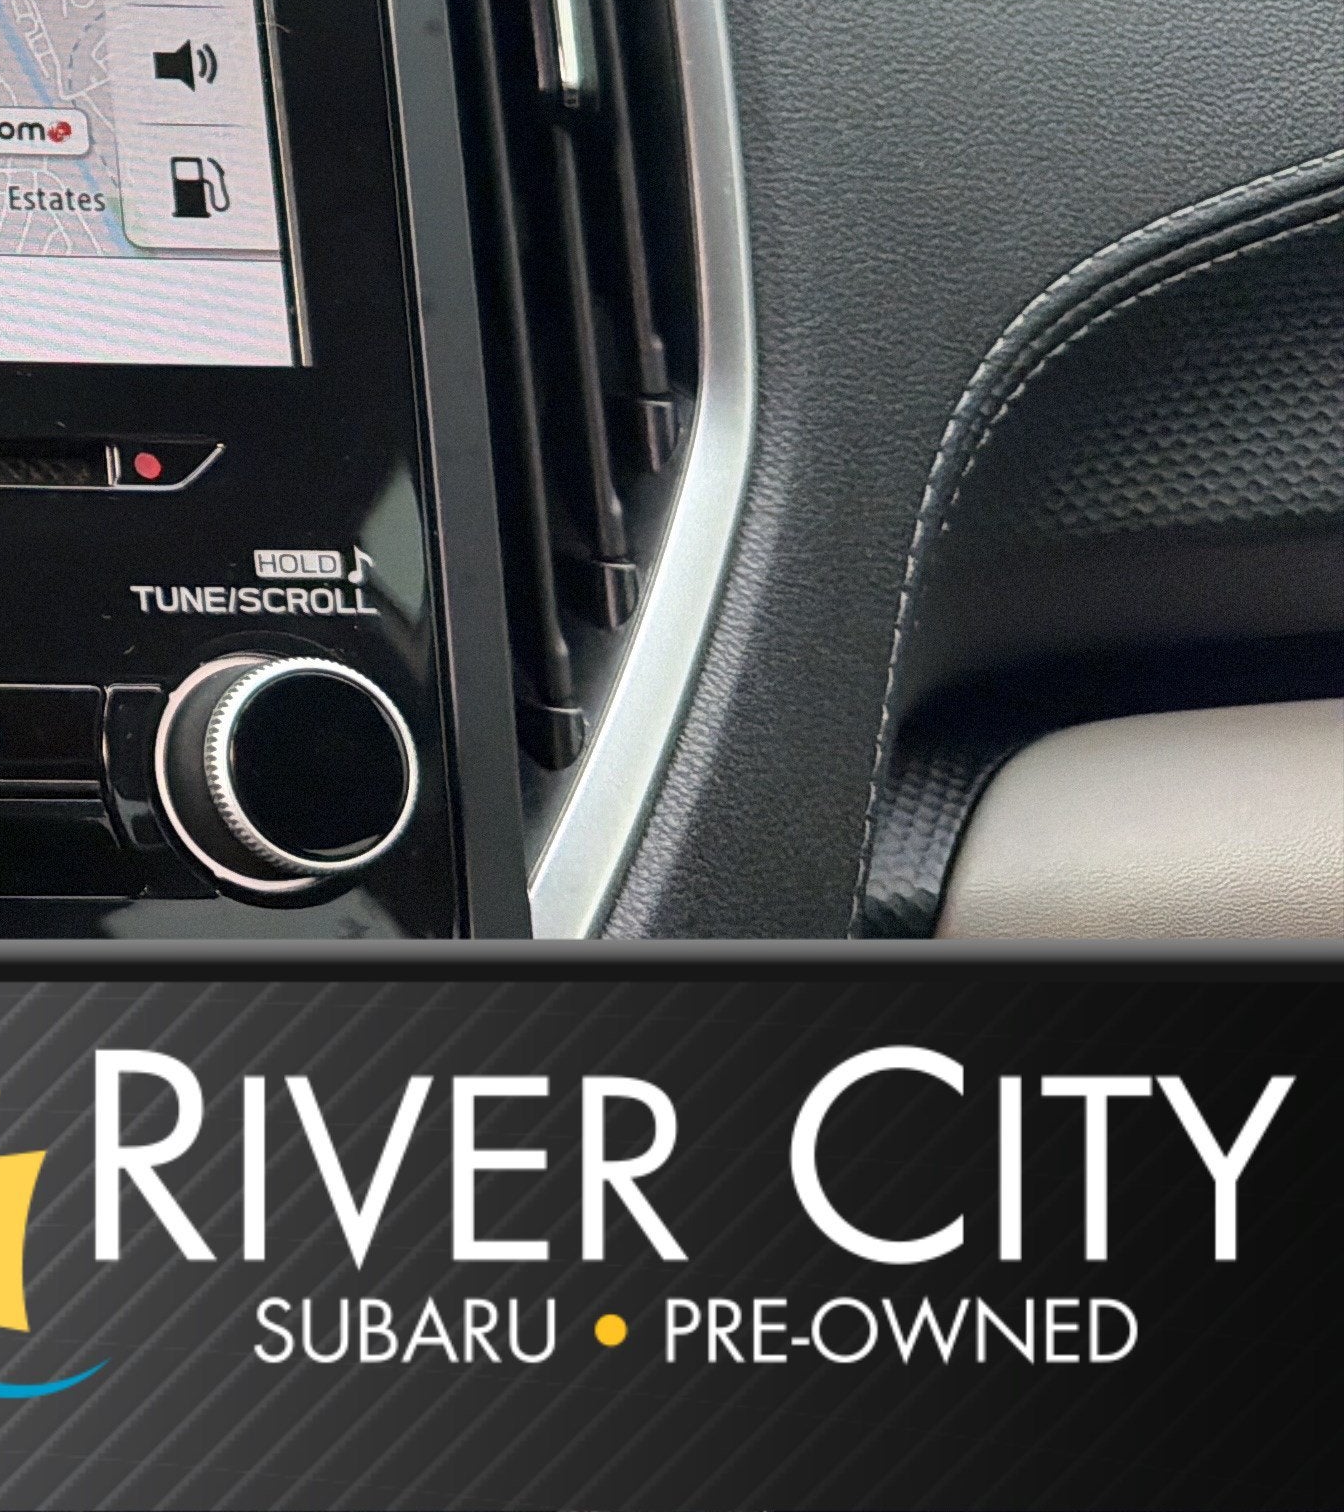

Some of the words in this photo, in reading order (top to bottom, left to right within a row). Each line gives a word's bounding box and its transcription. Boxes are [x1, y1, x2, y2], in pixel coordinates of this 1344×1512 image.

[8, 186, 106, 212] Estates
[256, 553, 338, 574] HOLD
[129, 585, 379, 615] TUNE/SCROLL
